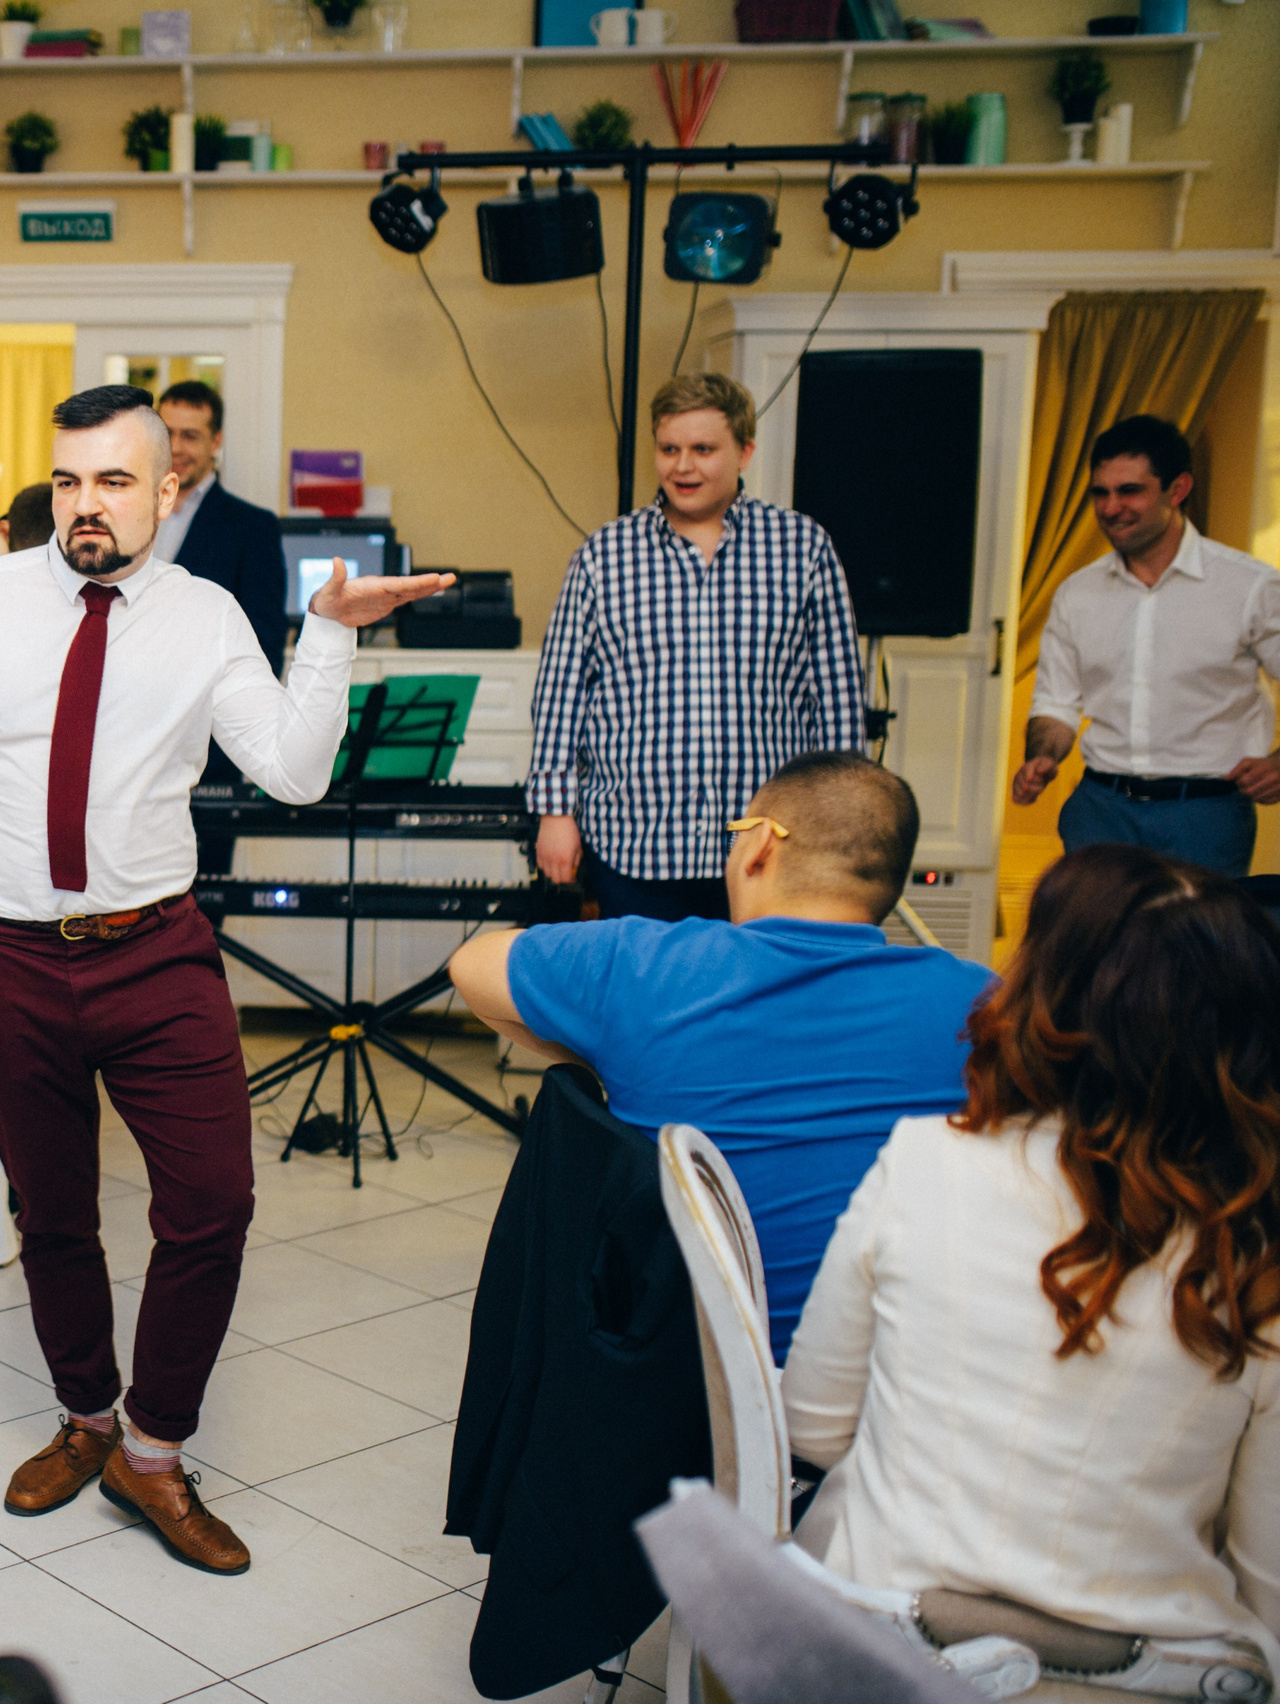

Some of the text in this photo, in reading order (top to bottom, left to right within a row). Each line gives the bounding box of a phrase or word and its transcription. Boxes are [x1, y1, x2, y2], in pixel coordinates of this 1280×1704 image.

[28, 218, 107, 238] ВЫХОД
[191, 785, 234, 798] AMAHA
[253, 890, 299, 909] KOG
